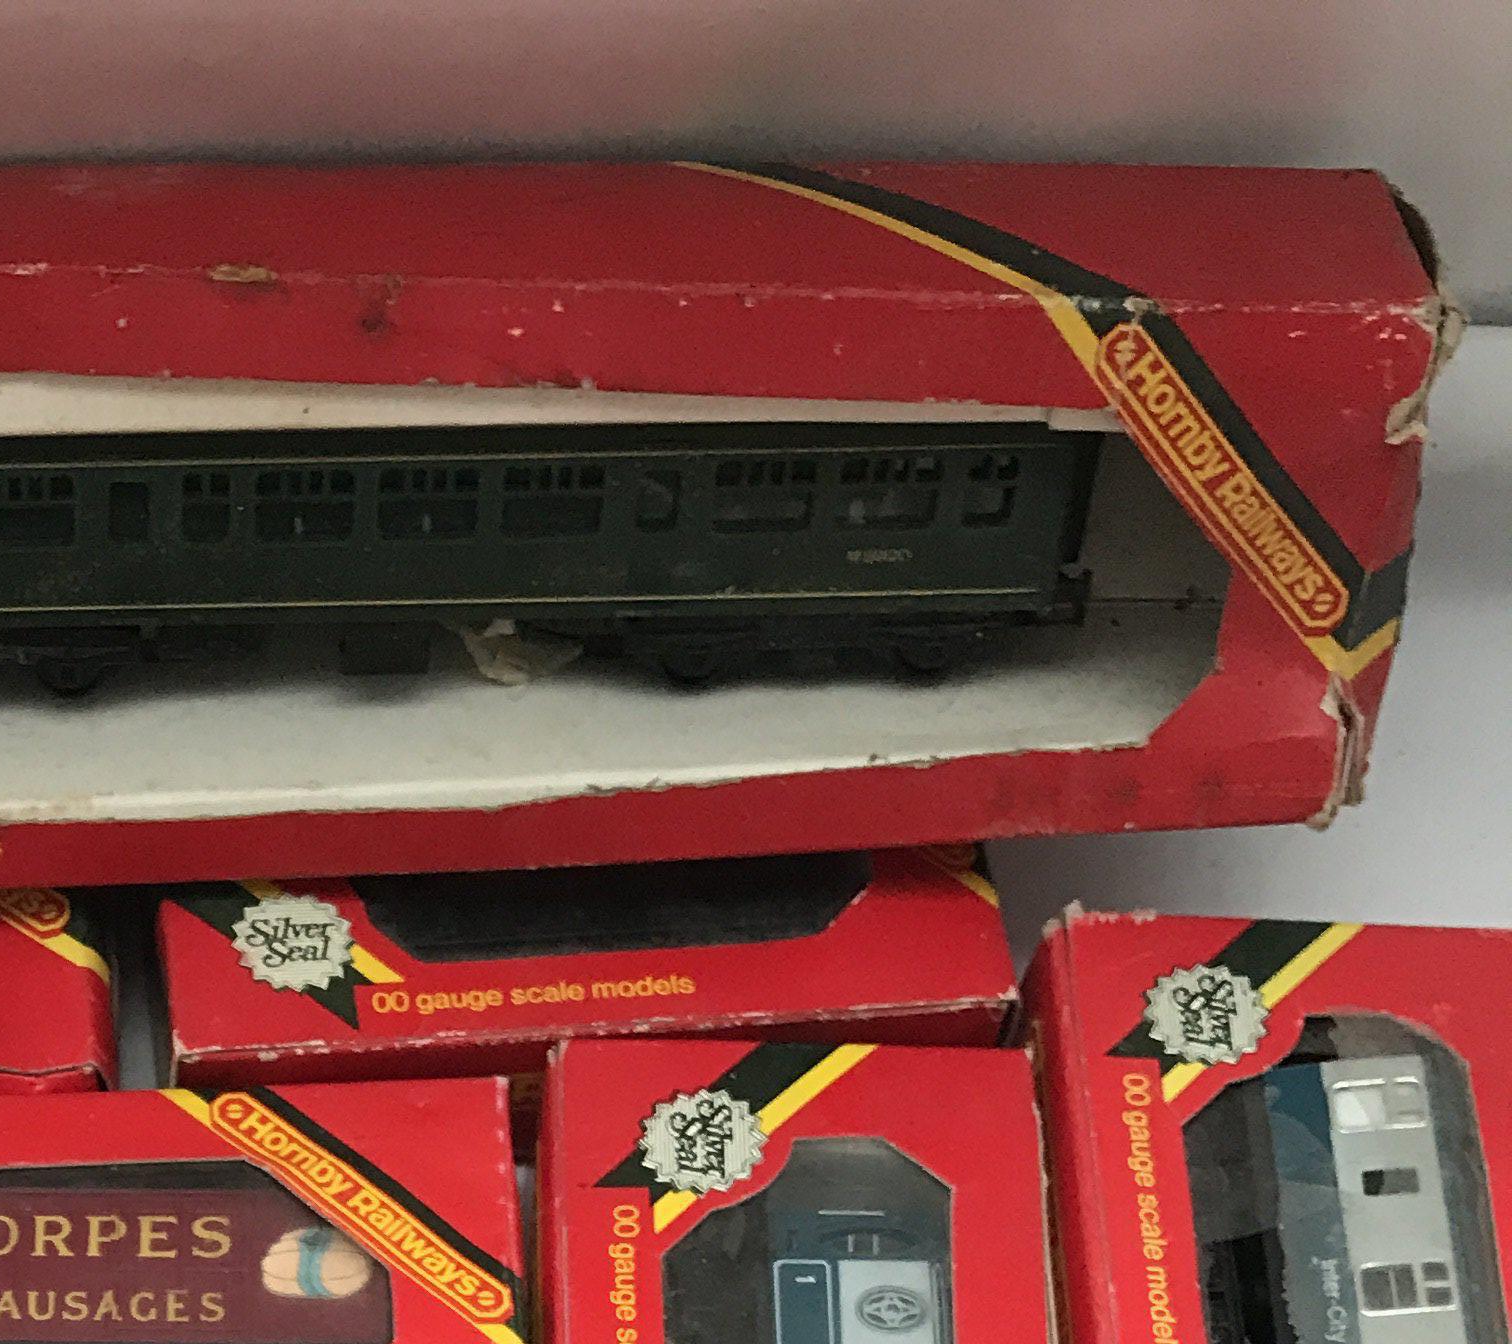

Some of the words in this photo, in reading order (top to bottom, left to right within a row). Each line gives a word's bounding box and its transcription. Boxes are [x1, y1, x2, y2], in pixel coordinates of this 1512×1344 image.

[1129, 350, 1230, 482] Hornby
[1216, 472, 1325, 600] Railways
[245, 917, 337, 950] Silver
[263, 938, 330, 968] Seal
[416, 987, 504, 1016] gauge
[510, 981, 585, 1007] scale
[591, 973, 698, 1000] models
[1172, 987, 1208, 1049] Seal
[1197, 975, 1238, 1051] Silver
[670, 1111, 707, 1176] Seal
[696, 1099, 733, 1179] Silver
[1121, 1110, 1156, 1189] gauge
[238, 1110, 355, 1198] Hornby
[346, 1187, 481, 1298] Railways
[1137, 1193, 1168, 1263] scale
[608, 1242, 638, 1322] gauge
